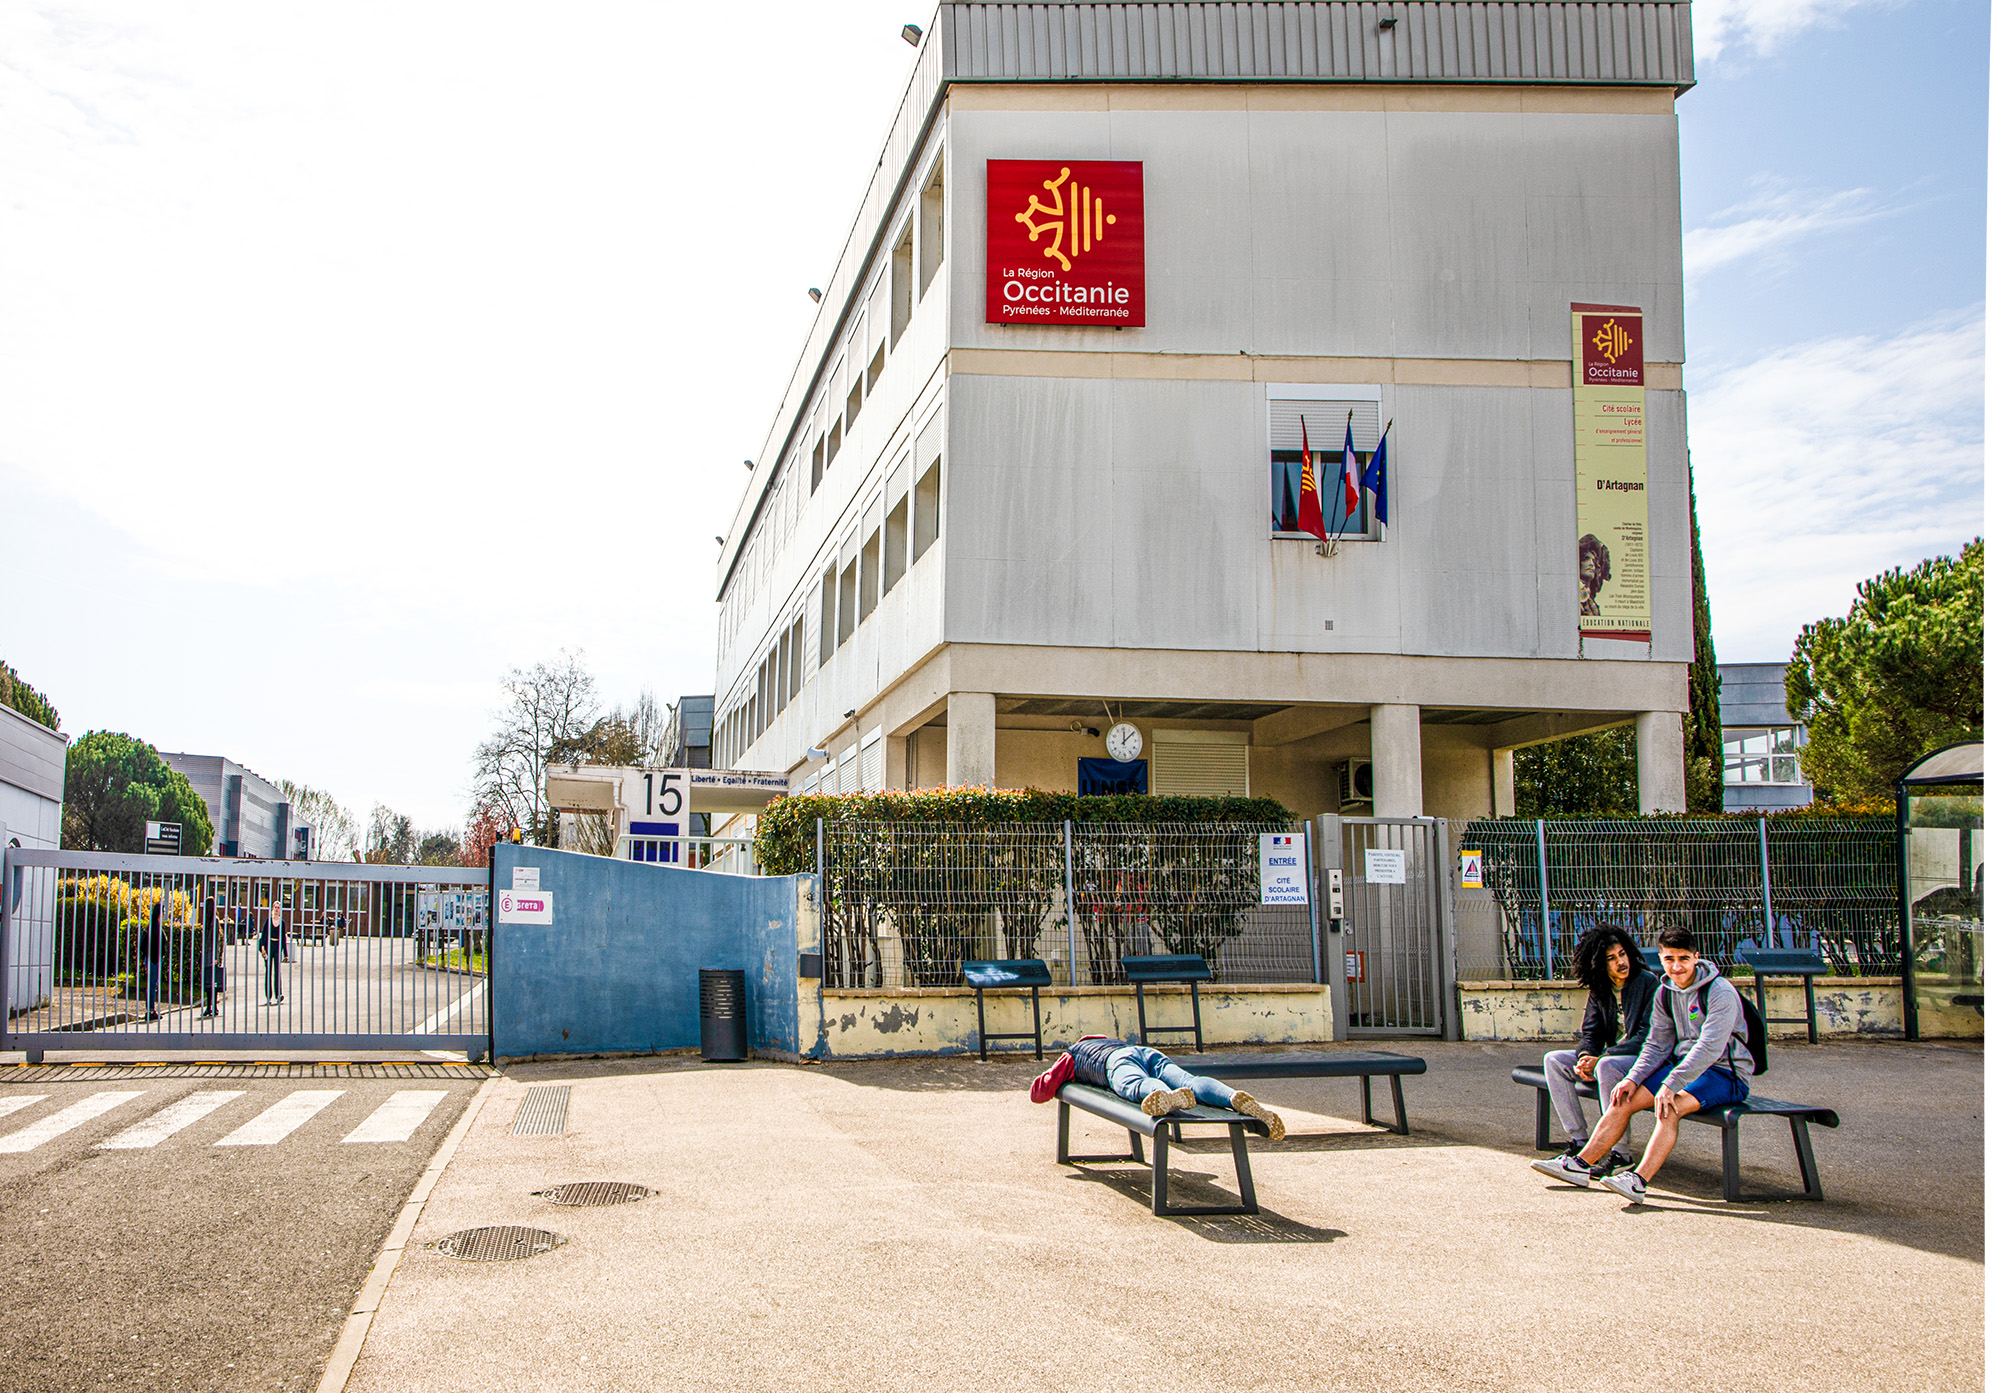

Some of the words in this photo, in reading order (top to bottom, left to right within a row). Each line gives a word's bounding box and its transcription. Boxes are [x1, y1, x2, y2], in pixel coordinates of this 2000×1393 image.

[1003, 268, 1014, 277] La
[1018, 268, 1055, 280] Région
[1003, 280, 1129, 304] Occitanie
[1003, 305, 1050, 316] Pyrénées
[1060, 306, 1129, 317] Méditerranée
[1589, 367, 1638, 377] Occitanie
[1602, 404, 1615, 413] Cité
[1616, 405, 1641, 413] scolaire
[1624, 418, 1642, 427] Lycée
[1596, 479, 1644, 493] D'Artagnan
[1617, 619, 1650, 628] NATIONALE
[691, 775, 716, 783] Liberté
[753, 777, 788, 786] Fraternité
[643, 774, 683, 816] 15
[1268, 856, 1297, 865] ENTRÉE
